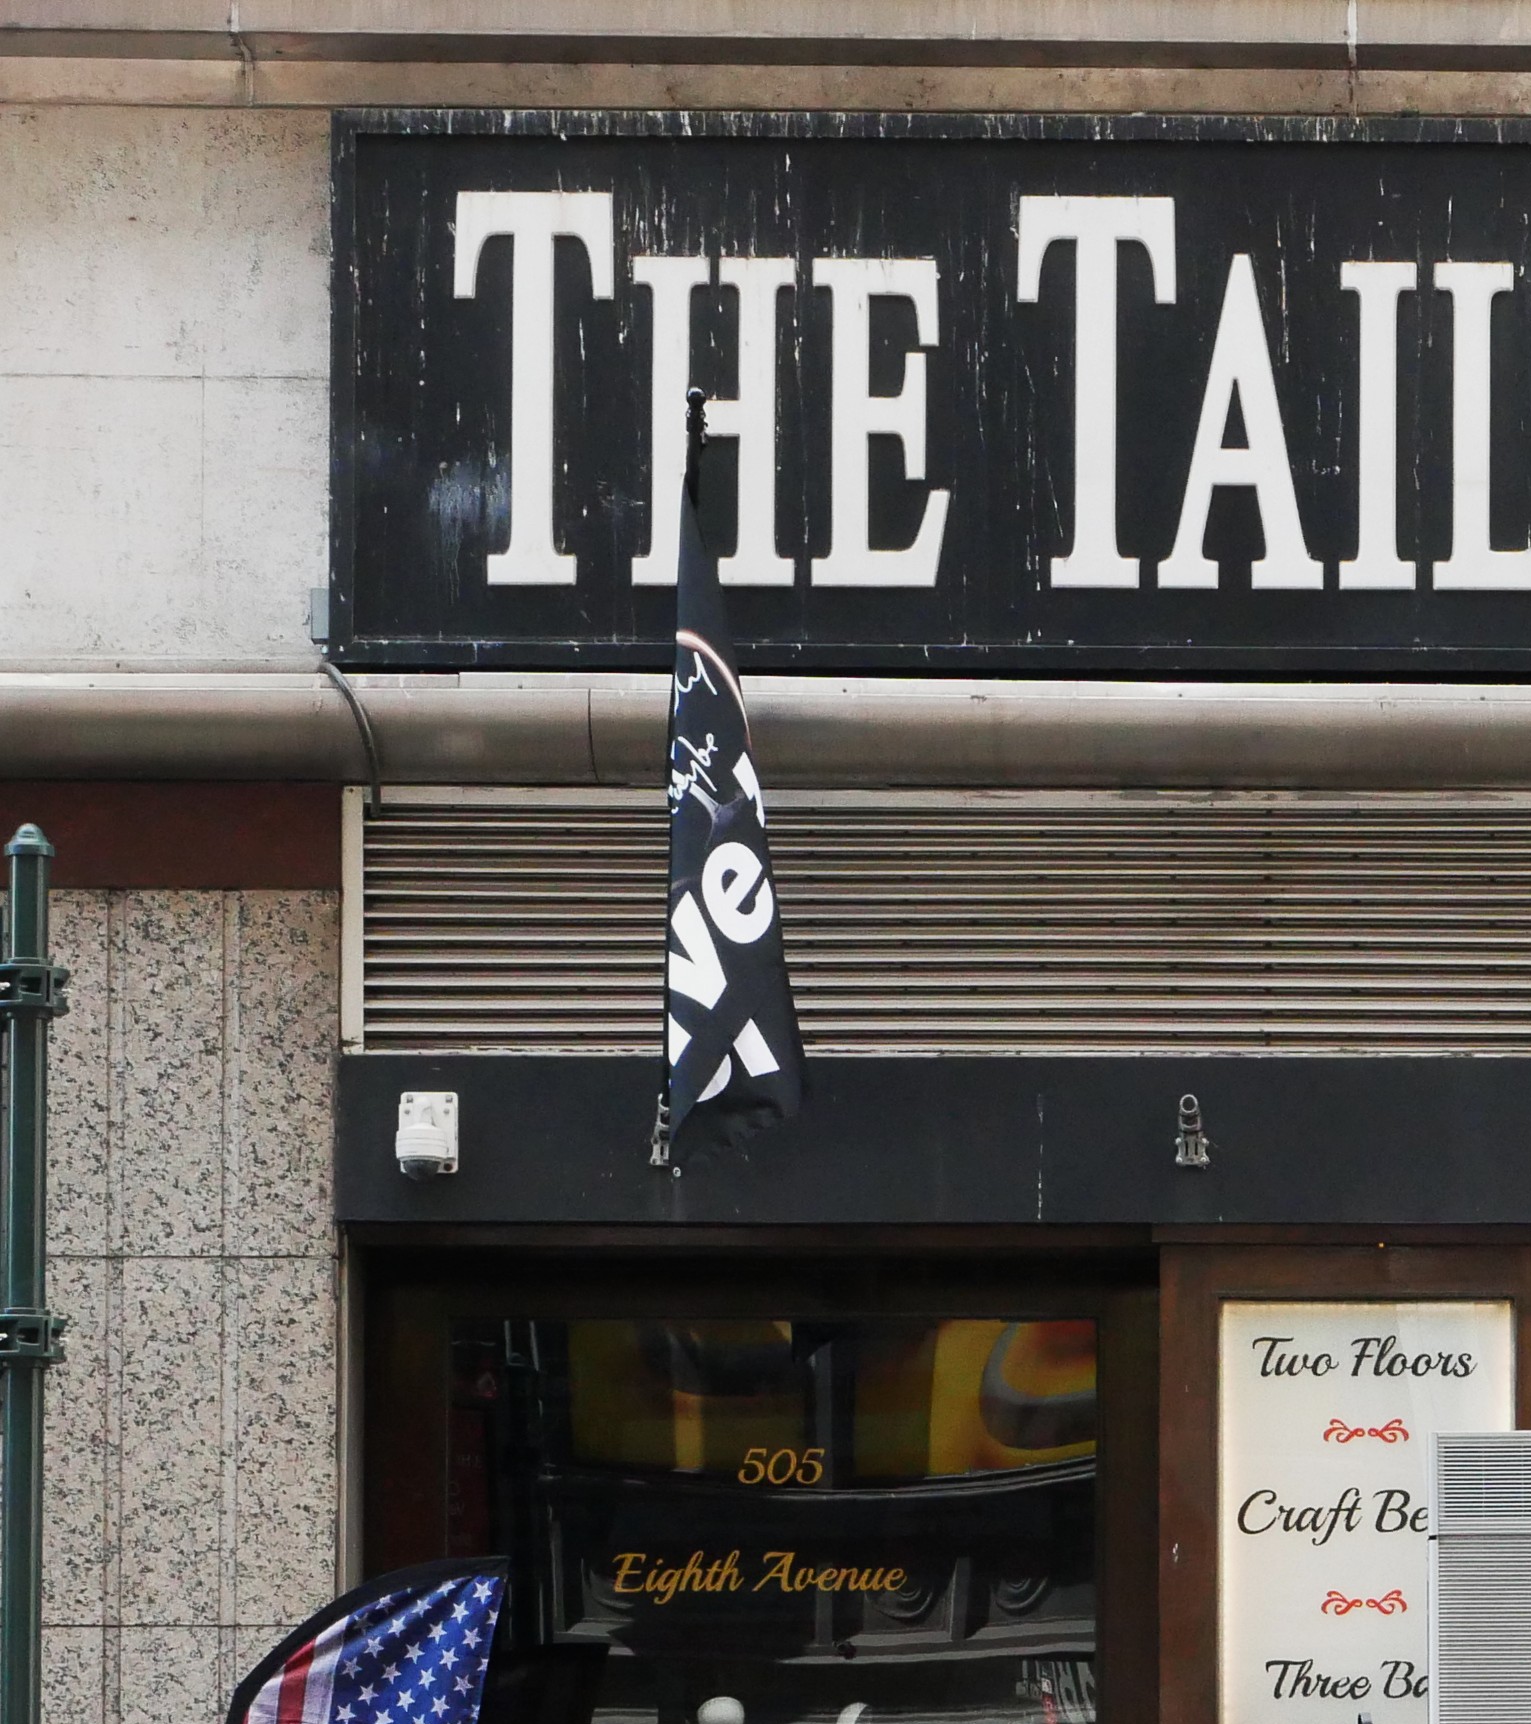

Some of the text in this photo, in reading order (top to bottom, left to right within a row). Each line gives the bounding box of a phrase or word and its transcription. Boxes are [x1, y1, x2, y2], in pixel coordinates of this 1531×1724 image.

[453, 190, 949, 587] THE
[1252, 1335, 1477, 1378] Two Floors
[738, 1448, 825, 1484] 505
[1238, 1487, 1429, 1545] Craft Be
[612, 1550, 907, 1605] Eighth Avenue
[1266, 1659, 1372, 1701] Three
